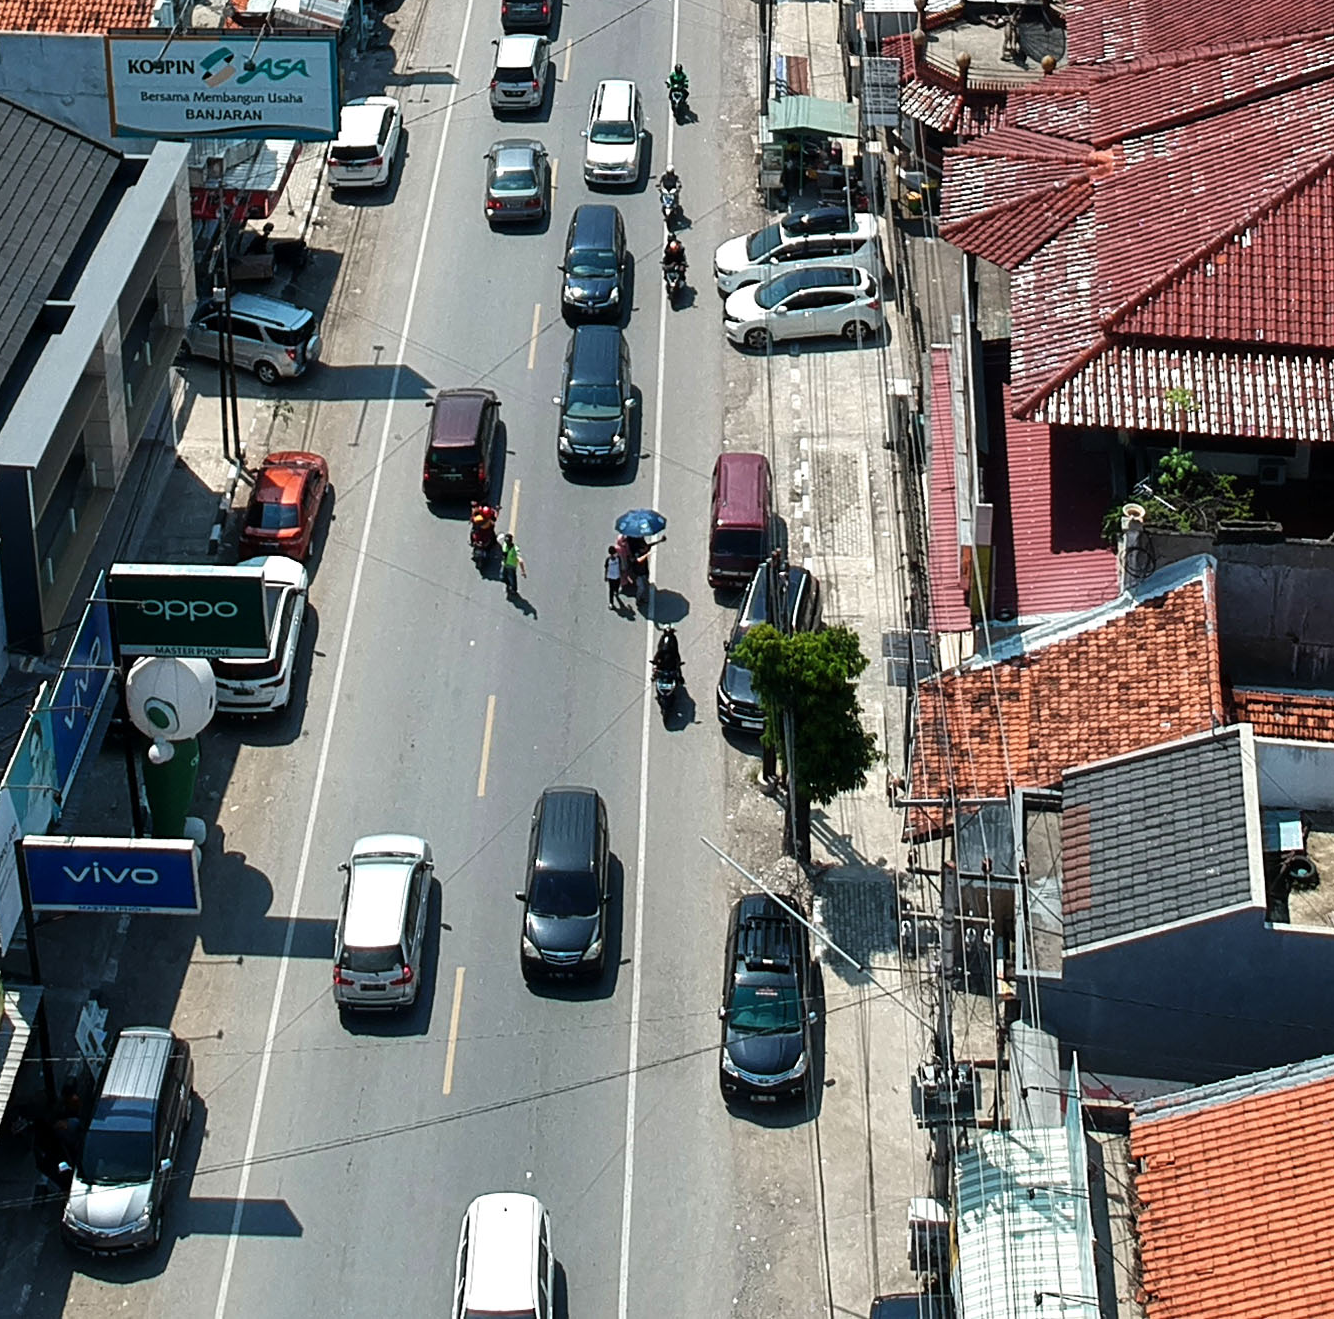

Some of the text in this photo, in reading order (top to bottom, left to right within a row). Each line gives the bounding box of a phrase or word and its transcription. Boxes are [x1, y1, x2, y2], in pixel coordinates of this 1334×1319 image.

[236, 54, 312, 84] JASA
[140, 91, 303, 106] Bersama Membangun Usaha
[185, 108, 263, 121] BANJARAN
[141, 599, 238, 622] oppo
[154, 646, 231, 657] MASTER PHONE
[64, 635, 101, 730] vivo
[62, 861, 159, 885] vivo
[77, 904, 117, 912] MASTER
